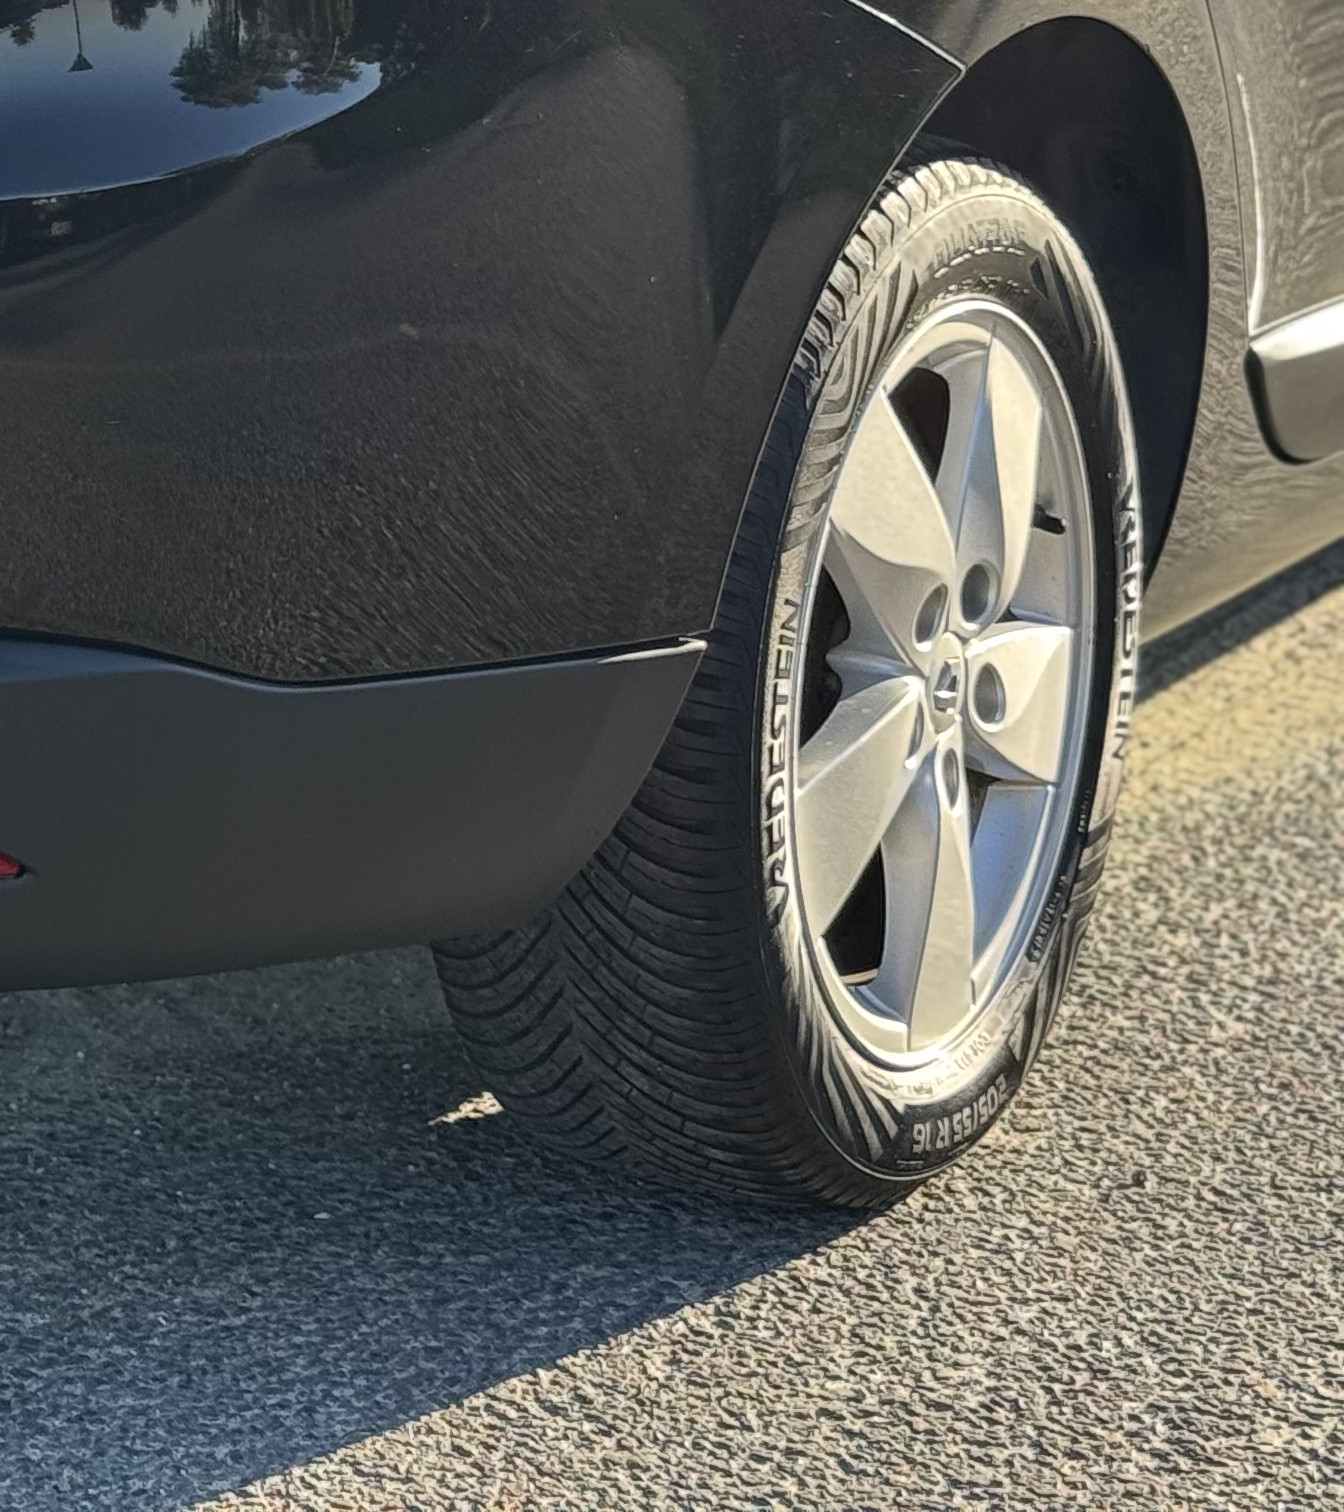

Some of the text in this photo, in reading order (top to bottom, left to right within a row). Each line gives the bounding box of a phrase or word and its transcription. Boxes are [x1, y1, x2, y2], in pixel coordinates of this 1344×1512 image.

[953, 1074, 1009, 1143] 205/55
[912, 1122, 933, 1154] 16
[936, 1117, 949, 1149] R
